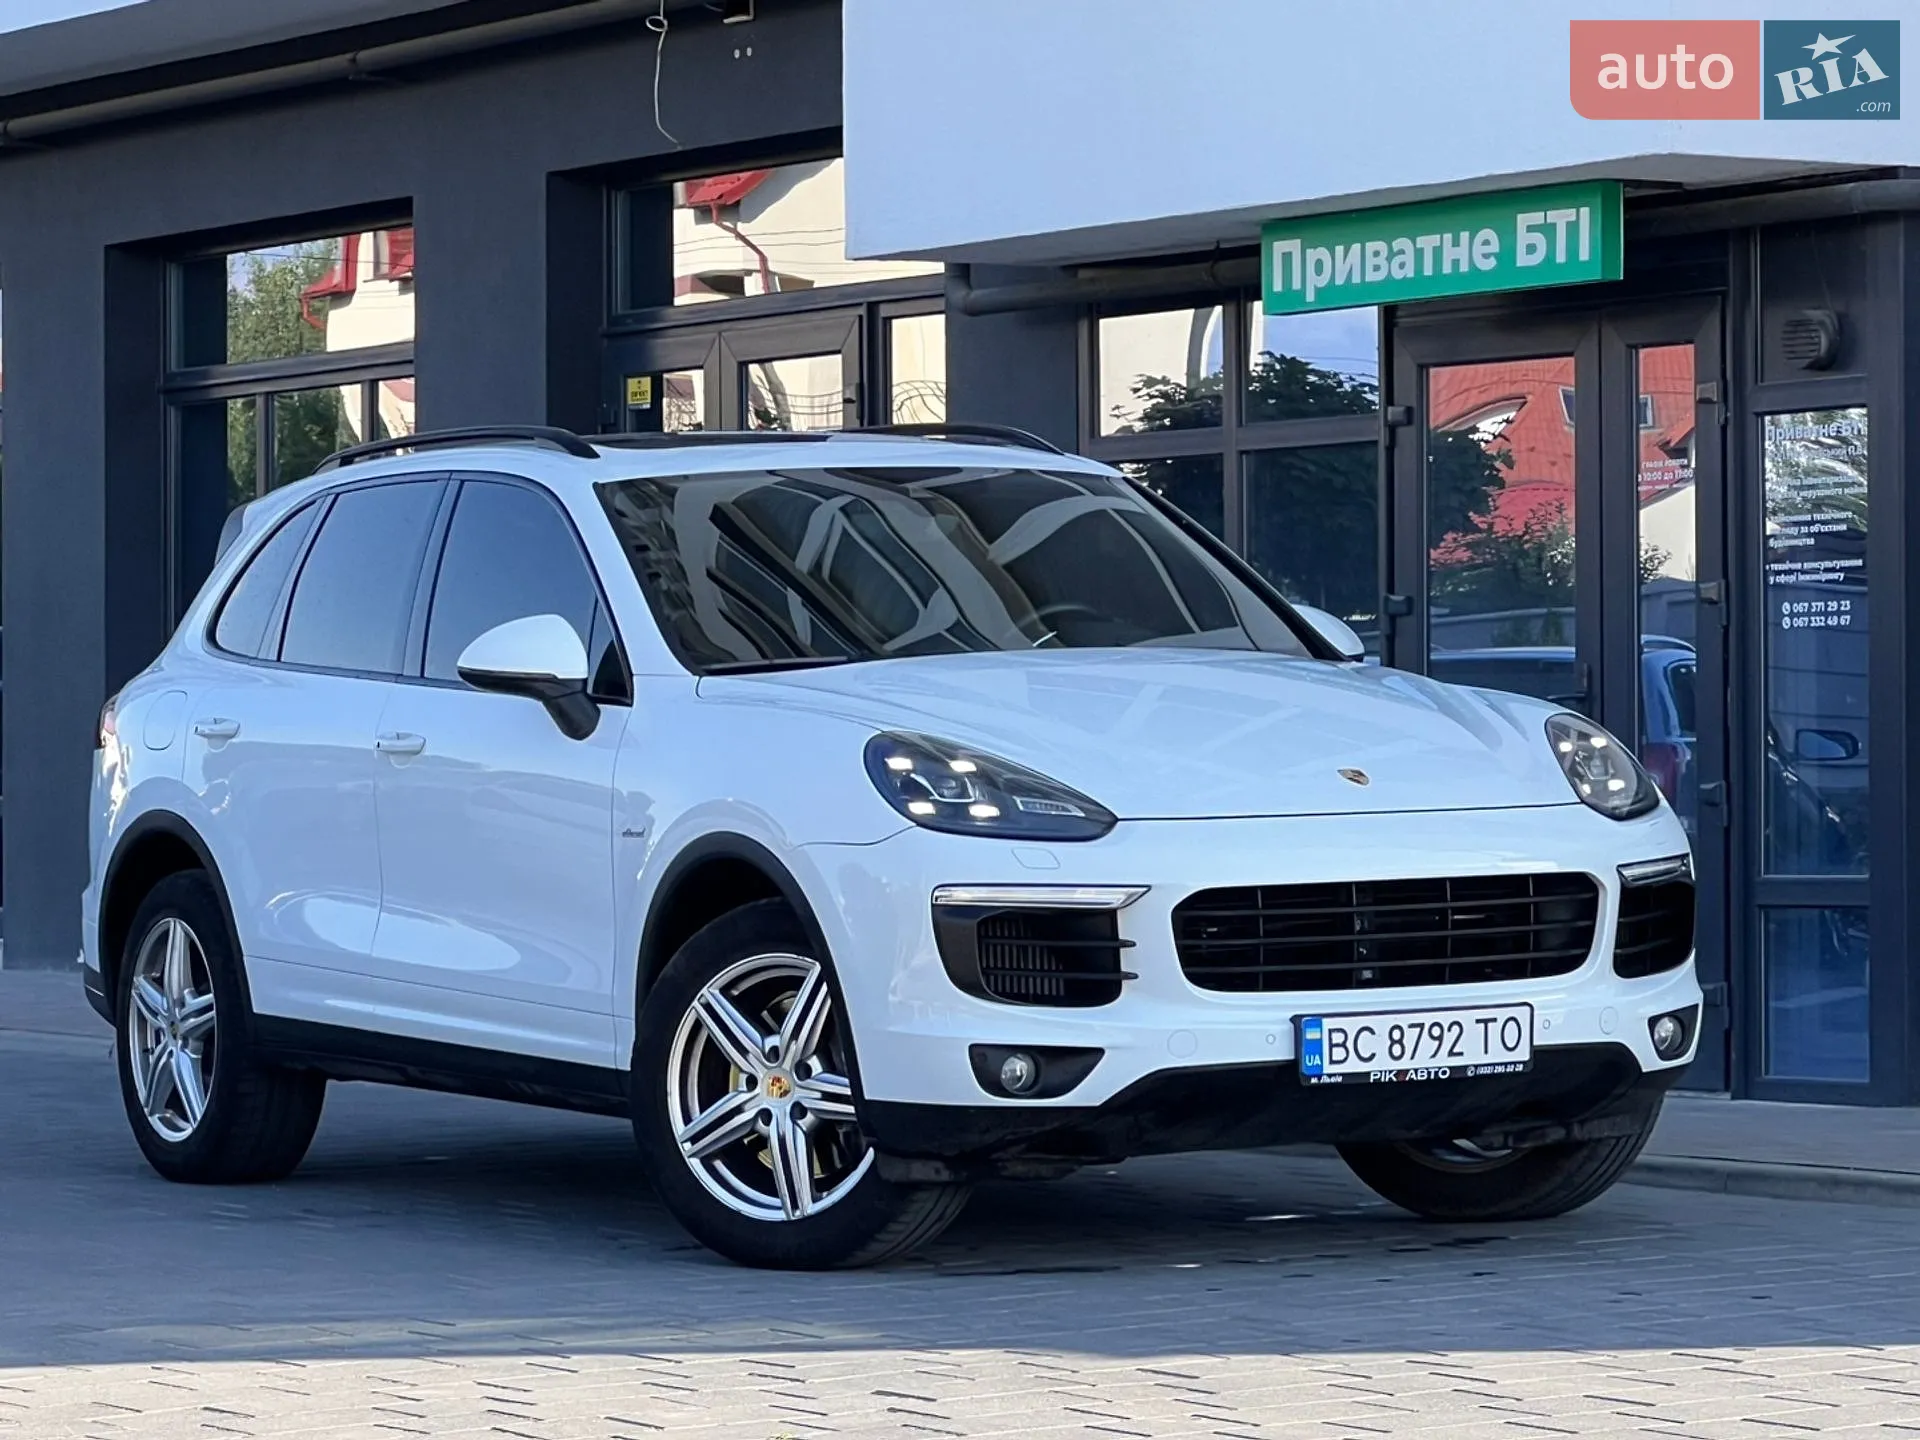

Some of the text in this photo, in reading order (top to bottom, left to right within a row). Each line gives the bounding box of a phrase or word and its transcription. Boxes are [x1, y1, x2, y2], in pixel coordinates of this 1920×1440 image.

[1272, 207, 1590, 302] Приватне БТІ
[1766, 423, 1836, 445] Приватне
[1792, 602, 1809, 613] 067
[1827, 601, 1838, 611] 29
[1840, 600, 1851, 611] 23
[1792, 616, 1809, 627] 067
[1810, 616, 1825, 627] 332
[1840, 615, 1851, 626] 67
[1328, 1016, 1522, 1066] BC 8792 TO
[1305, 1055, 1321, 1067] UA
[1406, 1067, 1450, 1081] АВТО
